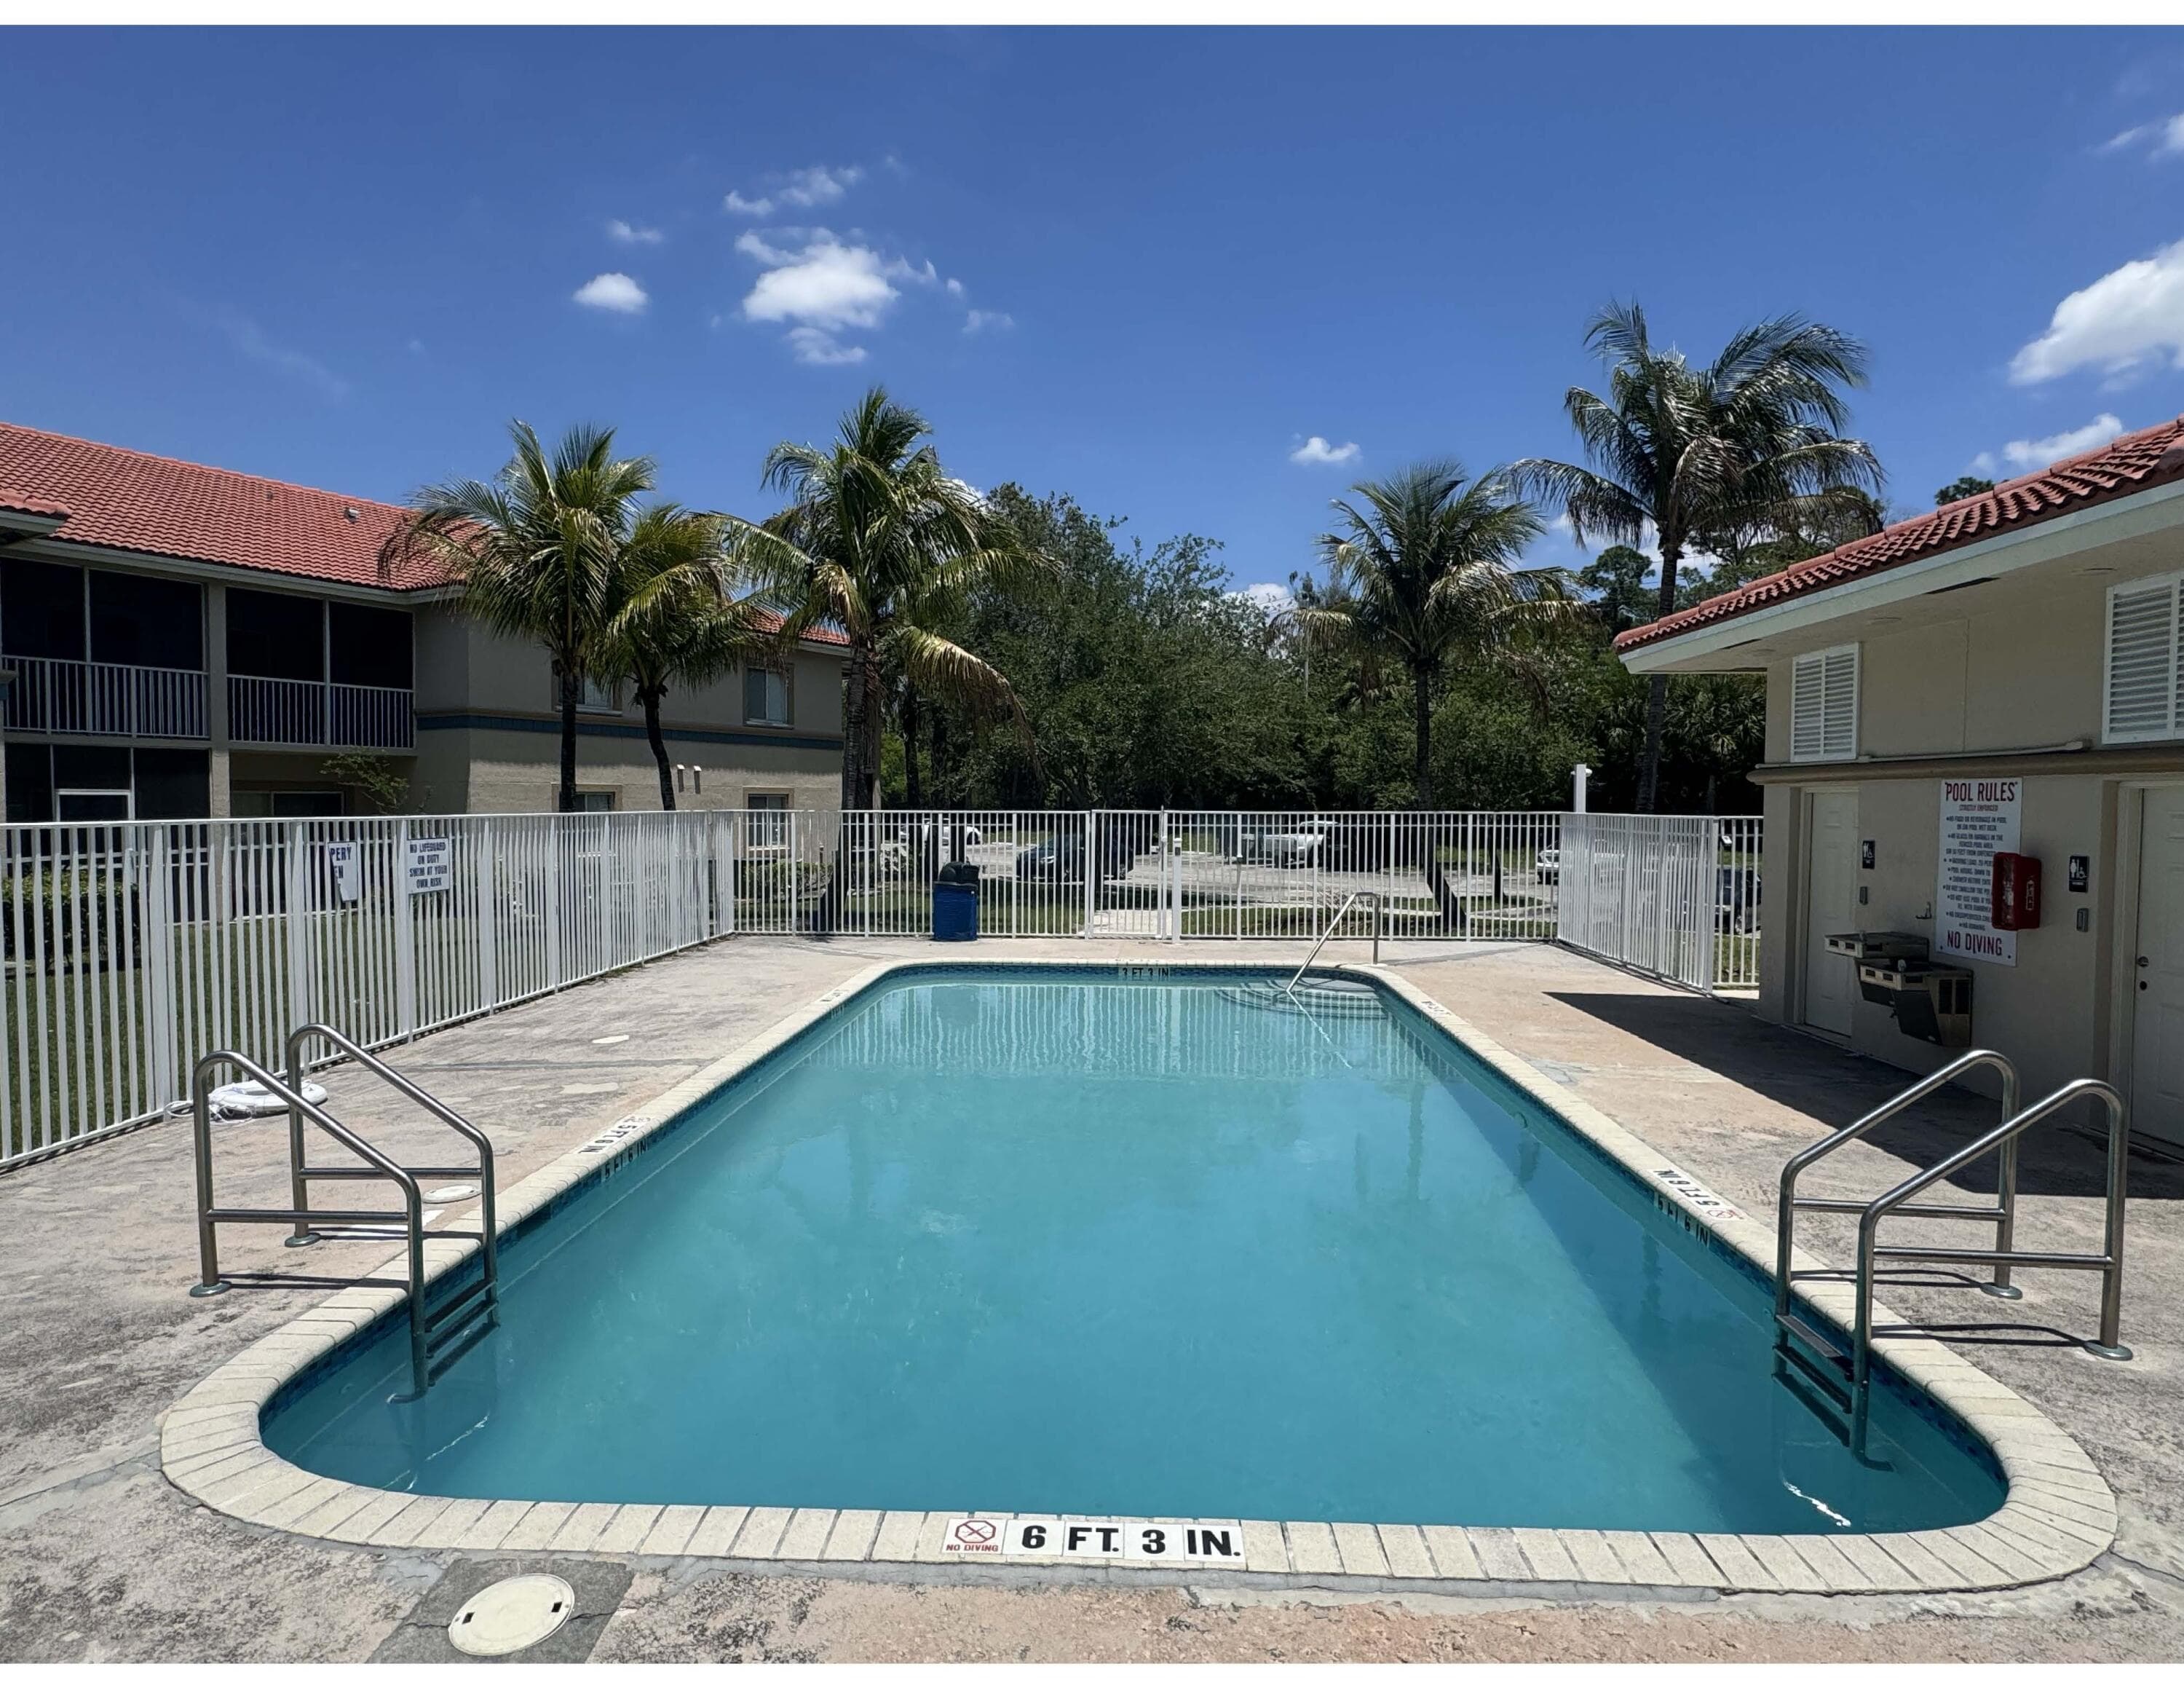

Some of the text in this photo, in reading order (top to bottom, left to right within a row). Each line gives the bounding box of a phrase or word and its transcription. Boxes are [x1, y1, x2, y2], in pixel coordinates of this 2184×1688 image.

[1945, 782, 2015, 802] POOL RULES
[410, 842, 446, 853] NO LIFEGUARD
[417, 854, 440, 865] ON DUTY
[409, 867, 425, 877] SWIM
[435, 865, 448, 875] YOUR
[416, 878, 428, 888] OWN
[1947, 930, 2003, 956] NO DIVING
[1021, 1525, 1241, 1557] 6 FT. 3 IN.
[946, 1544, 999, 1553] NO DIVING
